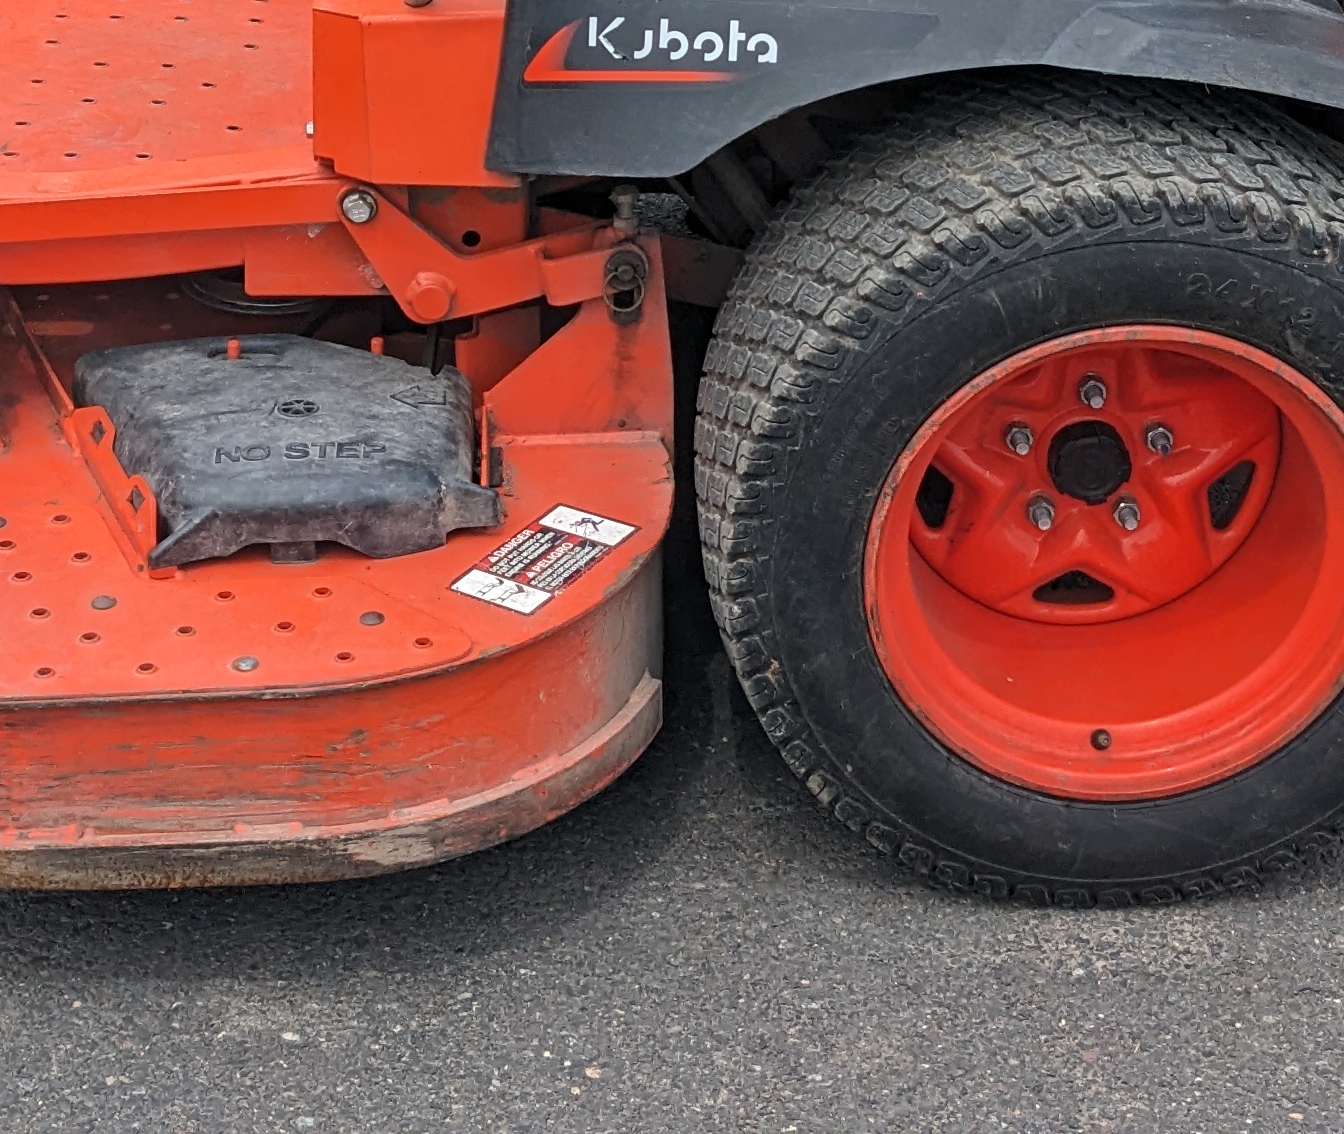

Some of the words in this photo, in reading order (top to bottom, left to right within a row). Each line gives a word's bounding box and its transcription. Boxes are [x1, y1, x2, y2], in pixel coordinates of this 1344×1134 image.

[588, 16, 778, 63] Kubota
[214, 445, 272, 464] NO
[283, 441, 387, 460] STEP
[494, 529, 536, 558] DANGER
[532, 542, 574, 572] PELIGRO
